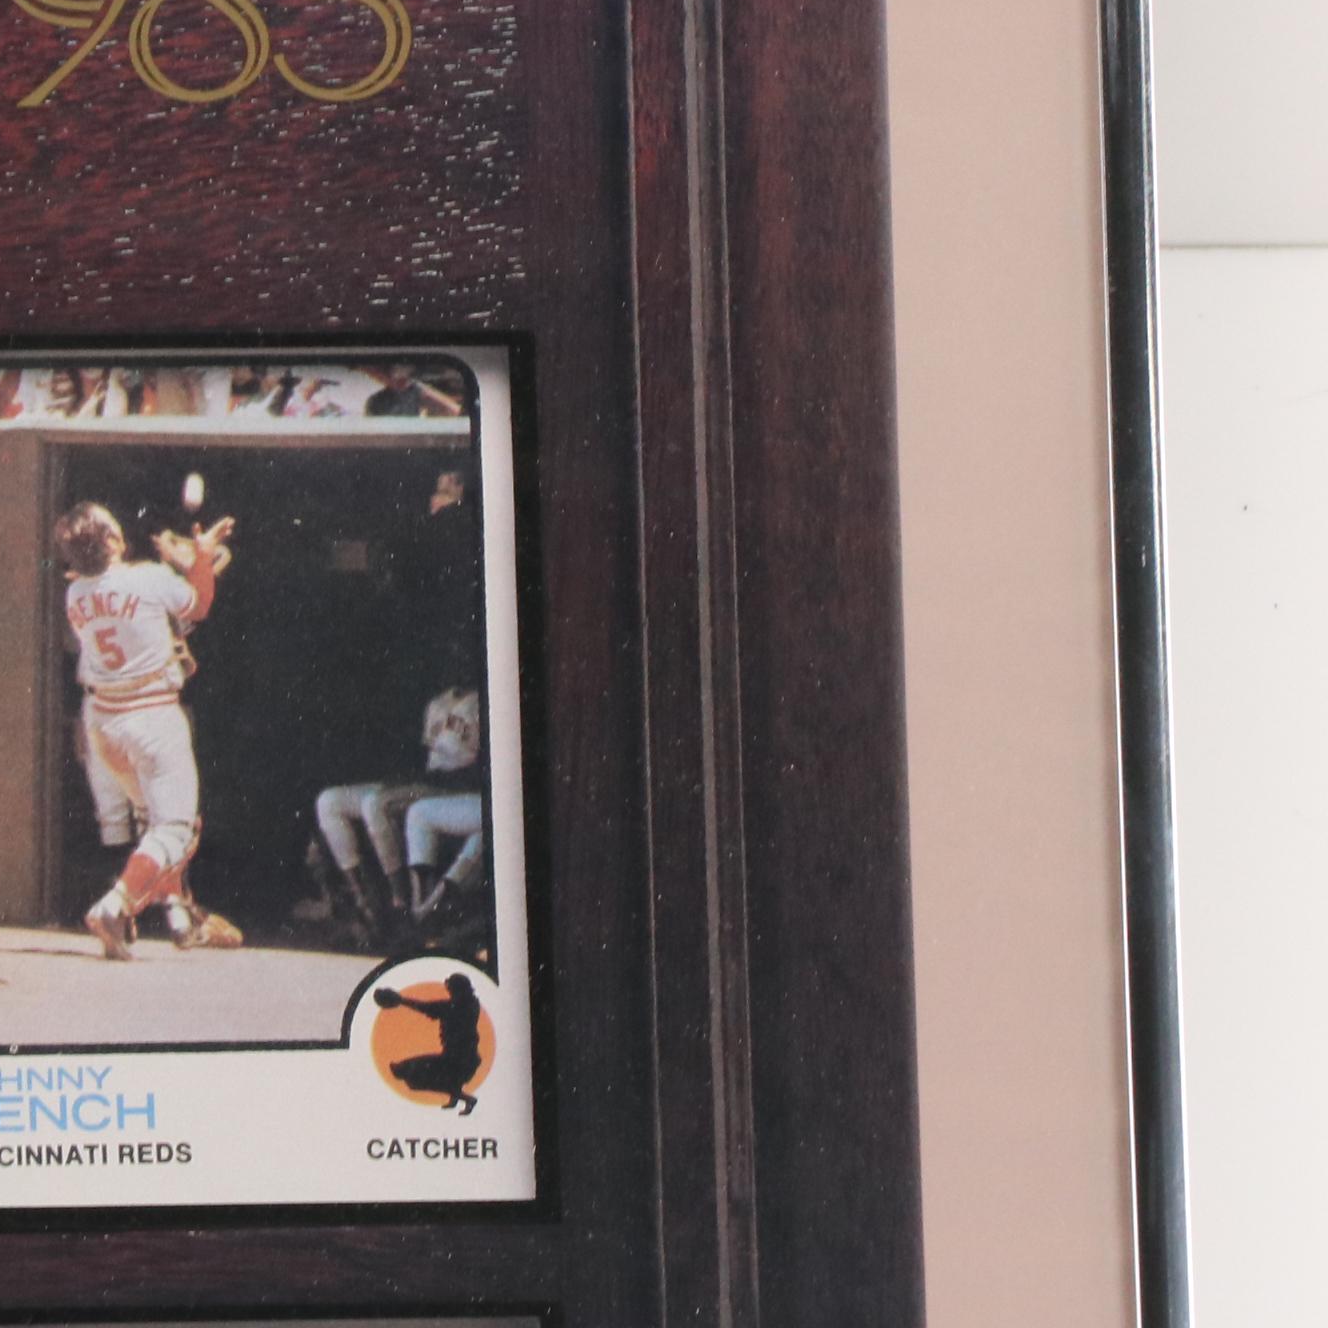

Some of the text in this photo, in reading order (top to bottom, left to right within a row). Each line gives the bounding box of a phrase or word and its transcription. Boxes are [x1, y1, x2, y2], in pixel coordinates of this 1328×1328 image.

[94, 626, 128, 670] 5
[118, 1141, 193, 1165] REDS
[367, 1139, 497, 1159] CATCHER
